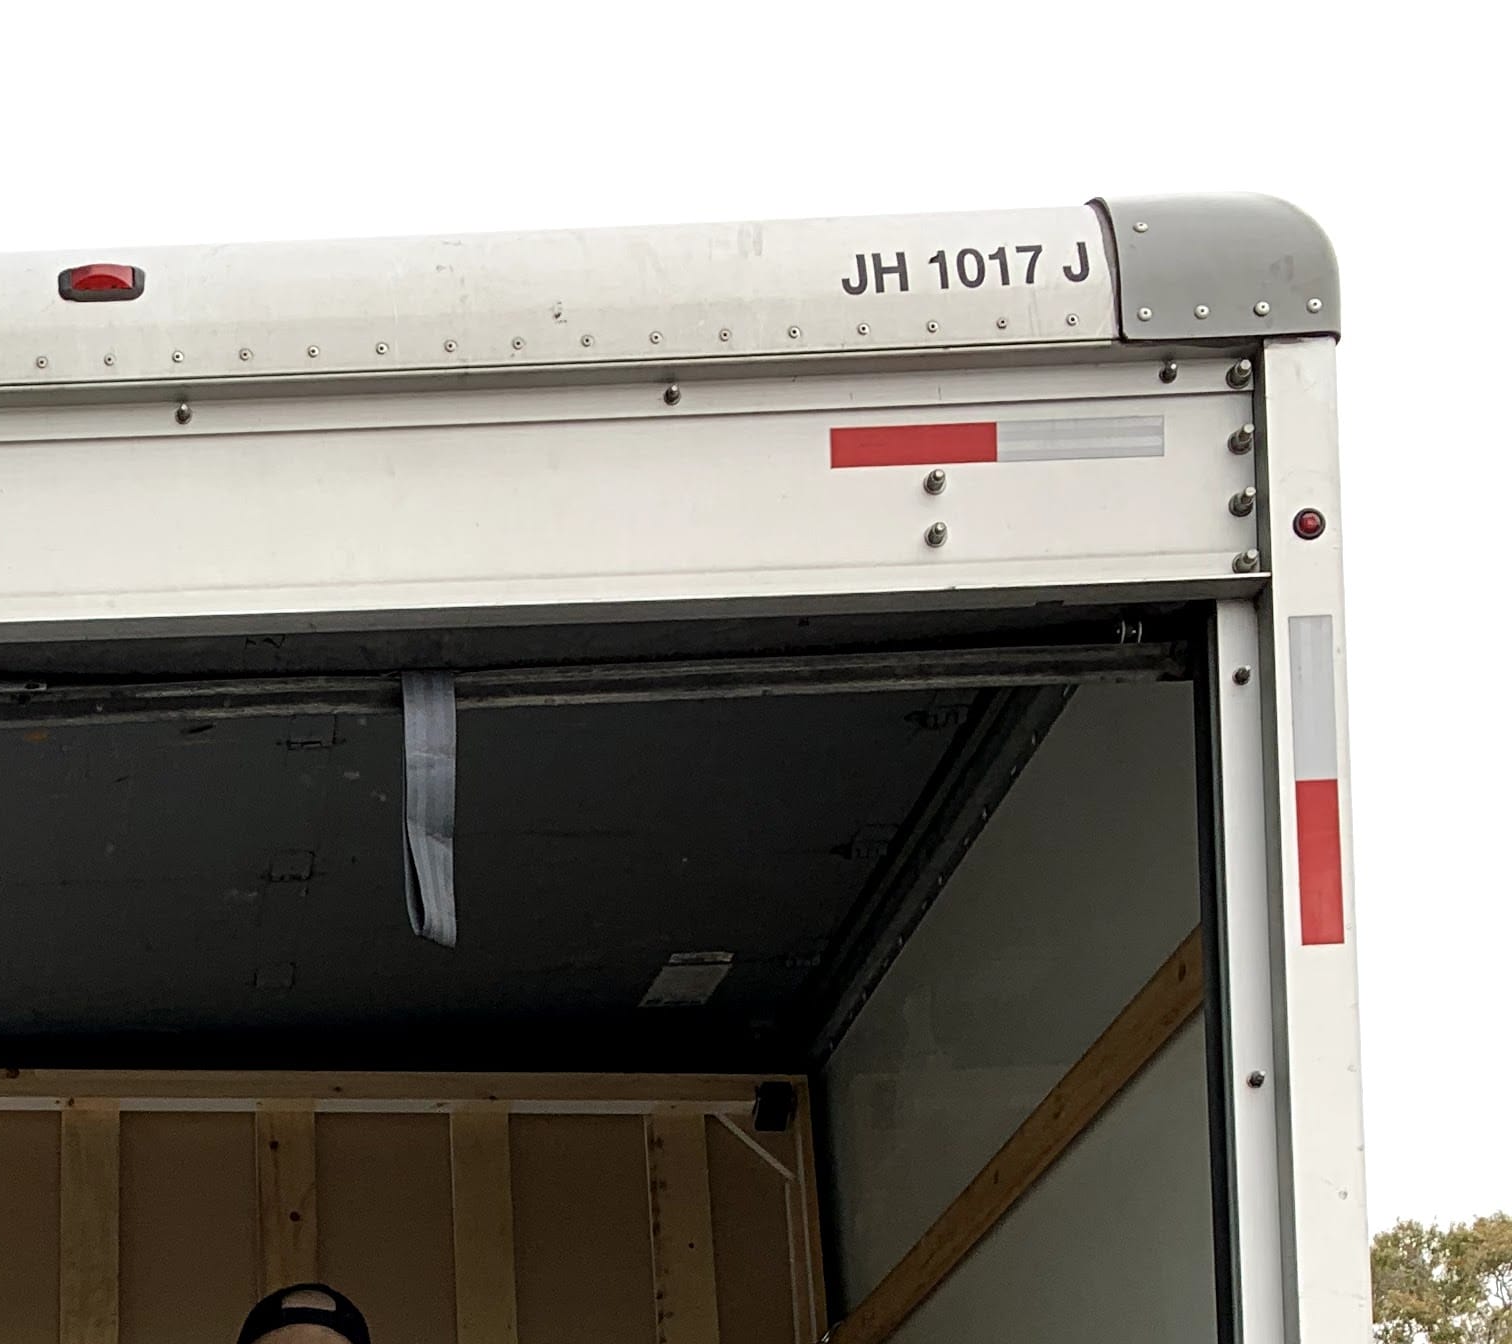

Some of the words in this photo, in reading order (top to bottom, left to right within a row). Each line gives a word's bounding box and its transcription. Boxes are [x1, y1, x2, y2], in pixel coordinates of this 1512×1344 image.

[841, 252, 909, 296] JH
[929, 245, 1043, 290] 1017
[1062, 241, 1090, 283] J
